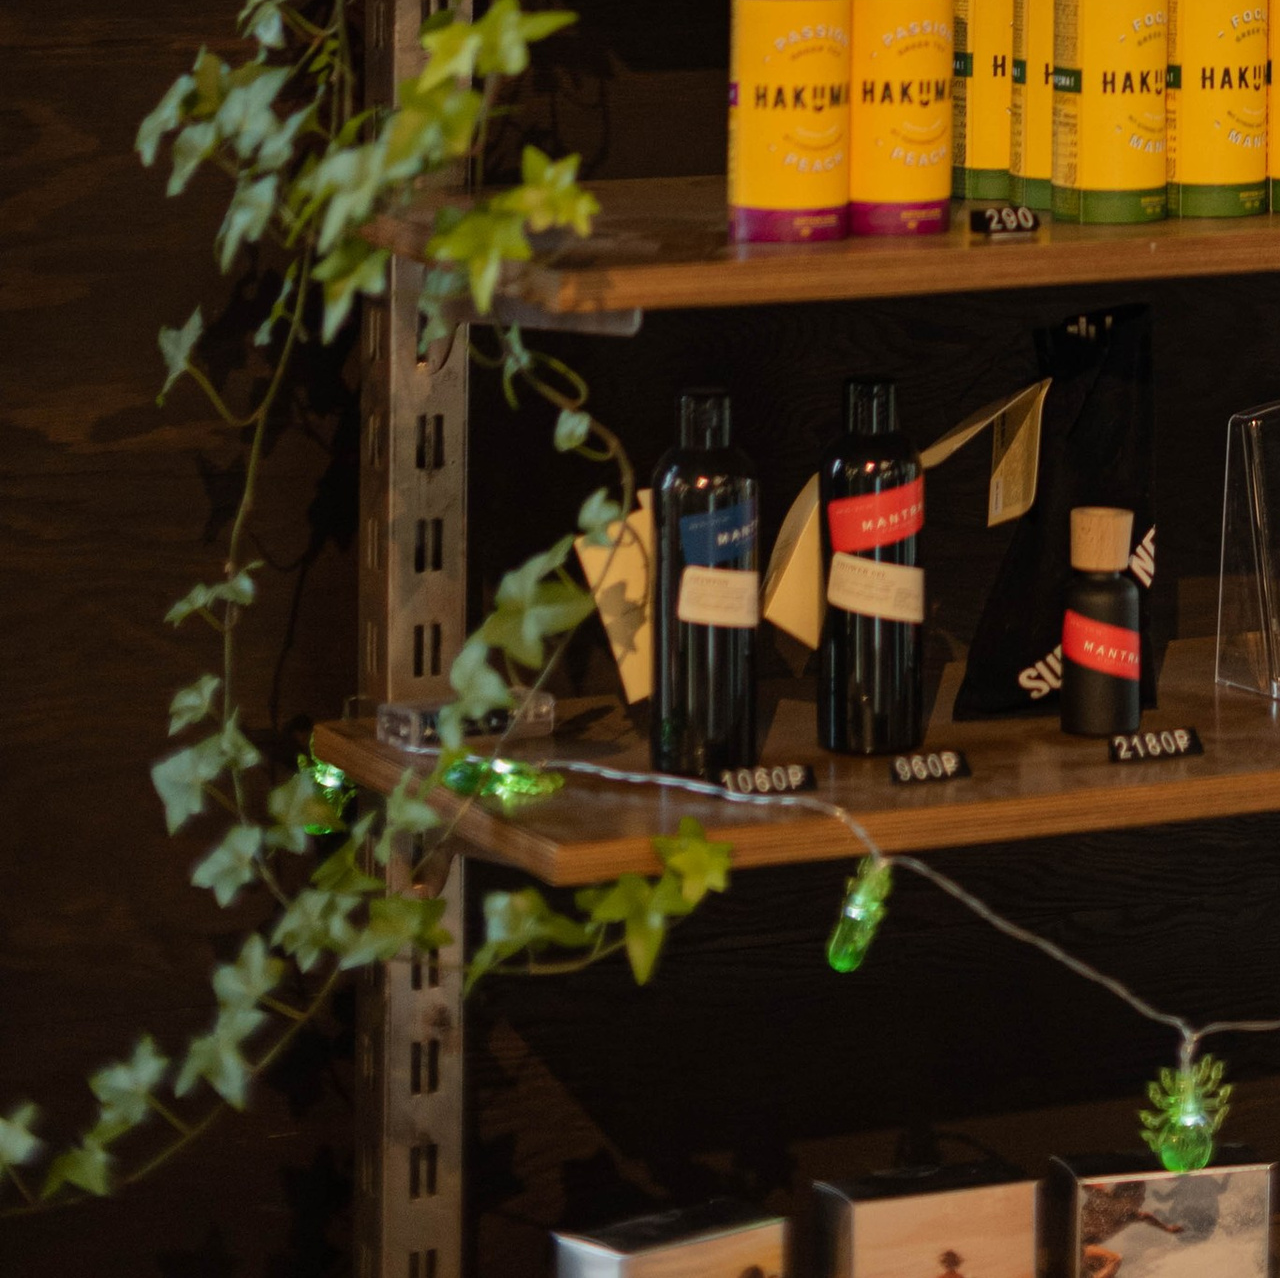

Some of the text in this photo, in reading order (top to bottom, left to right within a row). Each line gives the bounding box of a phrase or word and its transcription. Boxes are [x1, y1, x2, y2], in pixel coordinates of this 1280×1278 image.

[1132, 10, 1167, 32] FOC
[1102, 70, 1165, 95] HAKU
[1201, 66, 1266, 91] HAKU
[754, 80, 849, 112] HAKUM
[861, 78, 952, 107] HAKUM
[1129, 133, 1167, 153] MAN
